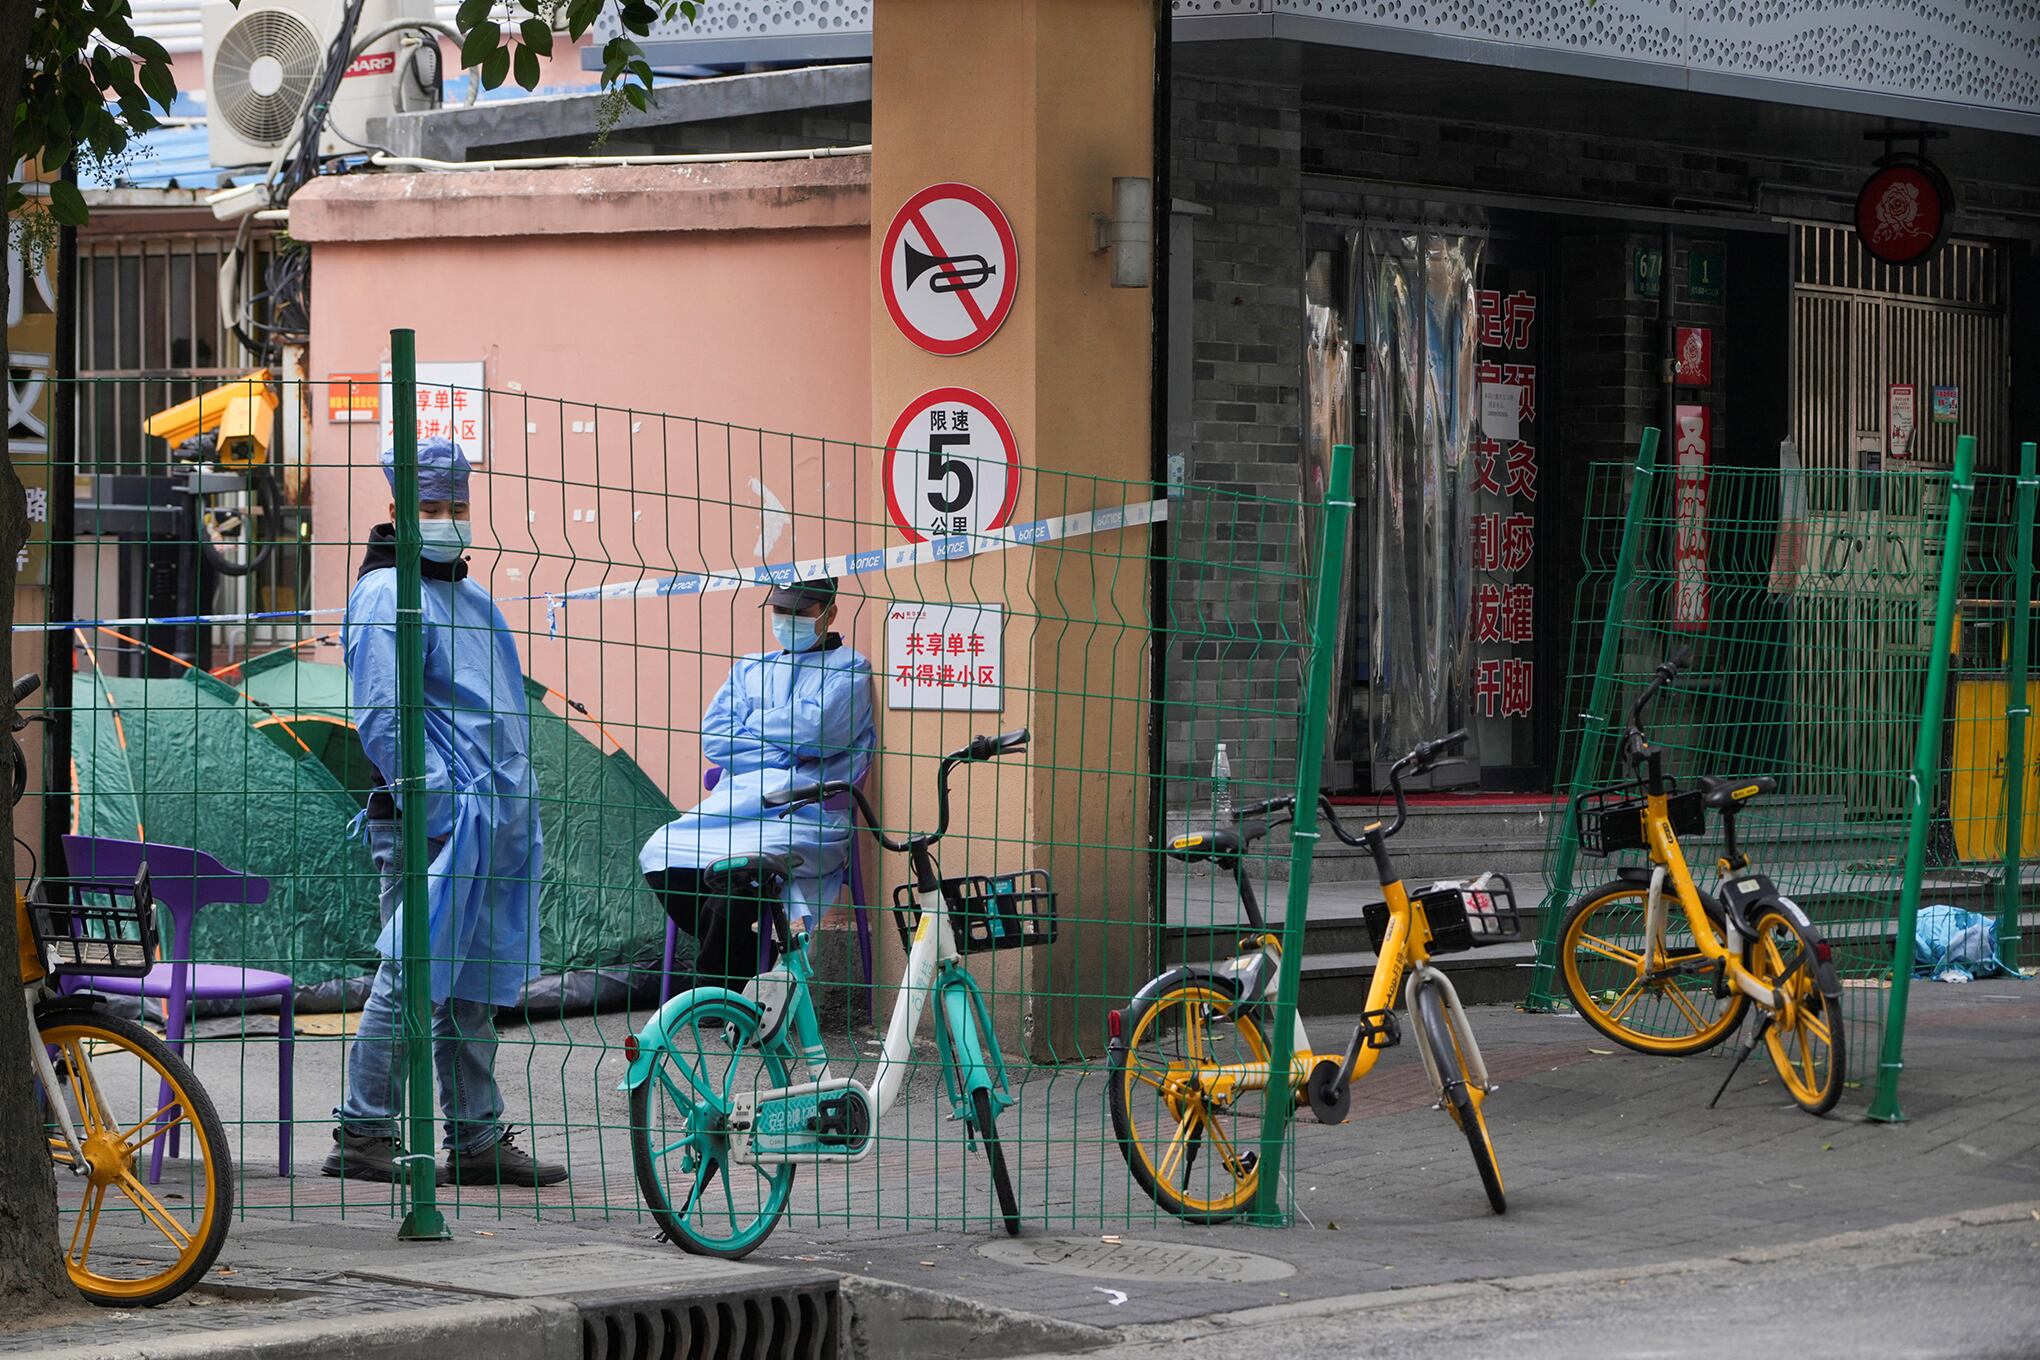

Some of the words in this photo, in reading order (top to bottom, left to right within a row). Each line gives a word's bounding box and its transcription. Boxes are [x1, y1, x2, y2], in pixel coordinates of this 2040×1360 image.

[346, 57, 393, 72] HARP
[1474, 289, 1537, 350] 足疗
[415, 389, 468, 411] 享单车
[388, 419, 476, 441] 进小区
[930, 409, 969, 431] 限速
[927, 433, 974, 514] 5
[1469, 436, 1539, 501] 艾灸
[931, 516, 968, 537] 公里
[1469, 512, 1535, 573] 刮痧
[1469, 583, 1534, 644] 拔罐
[906, 633, 985, 656] 共享单车
[895, 664, 995, 688] 不得进小区
